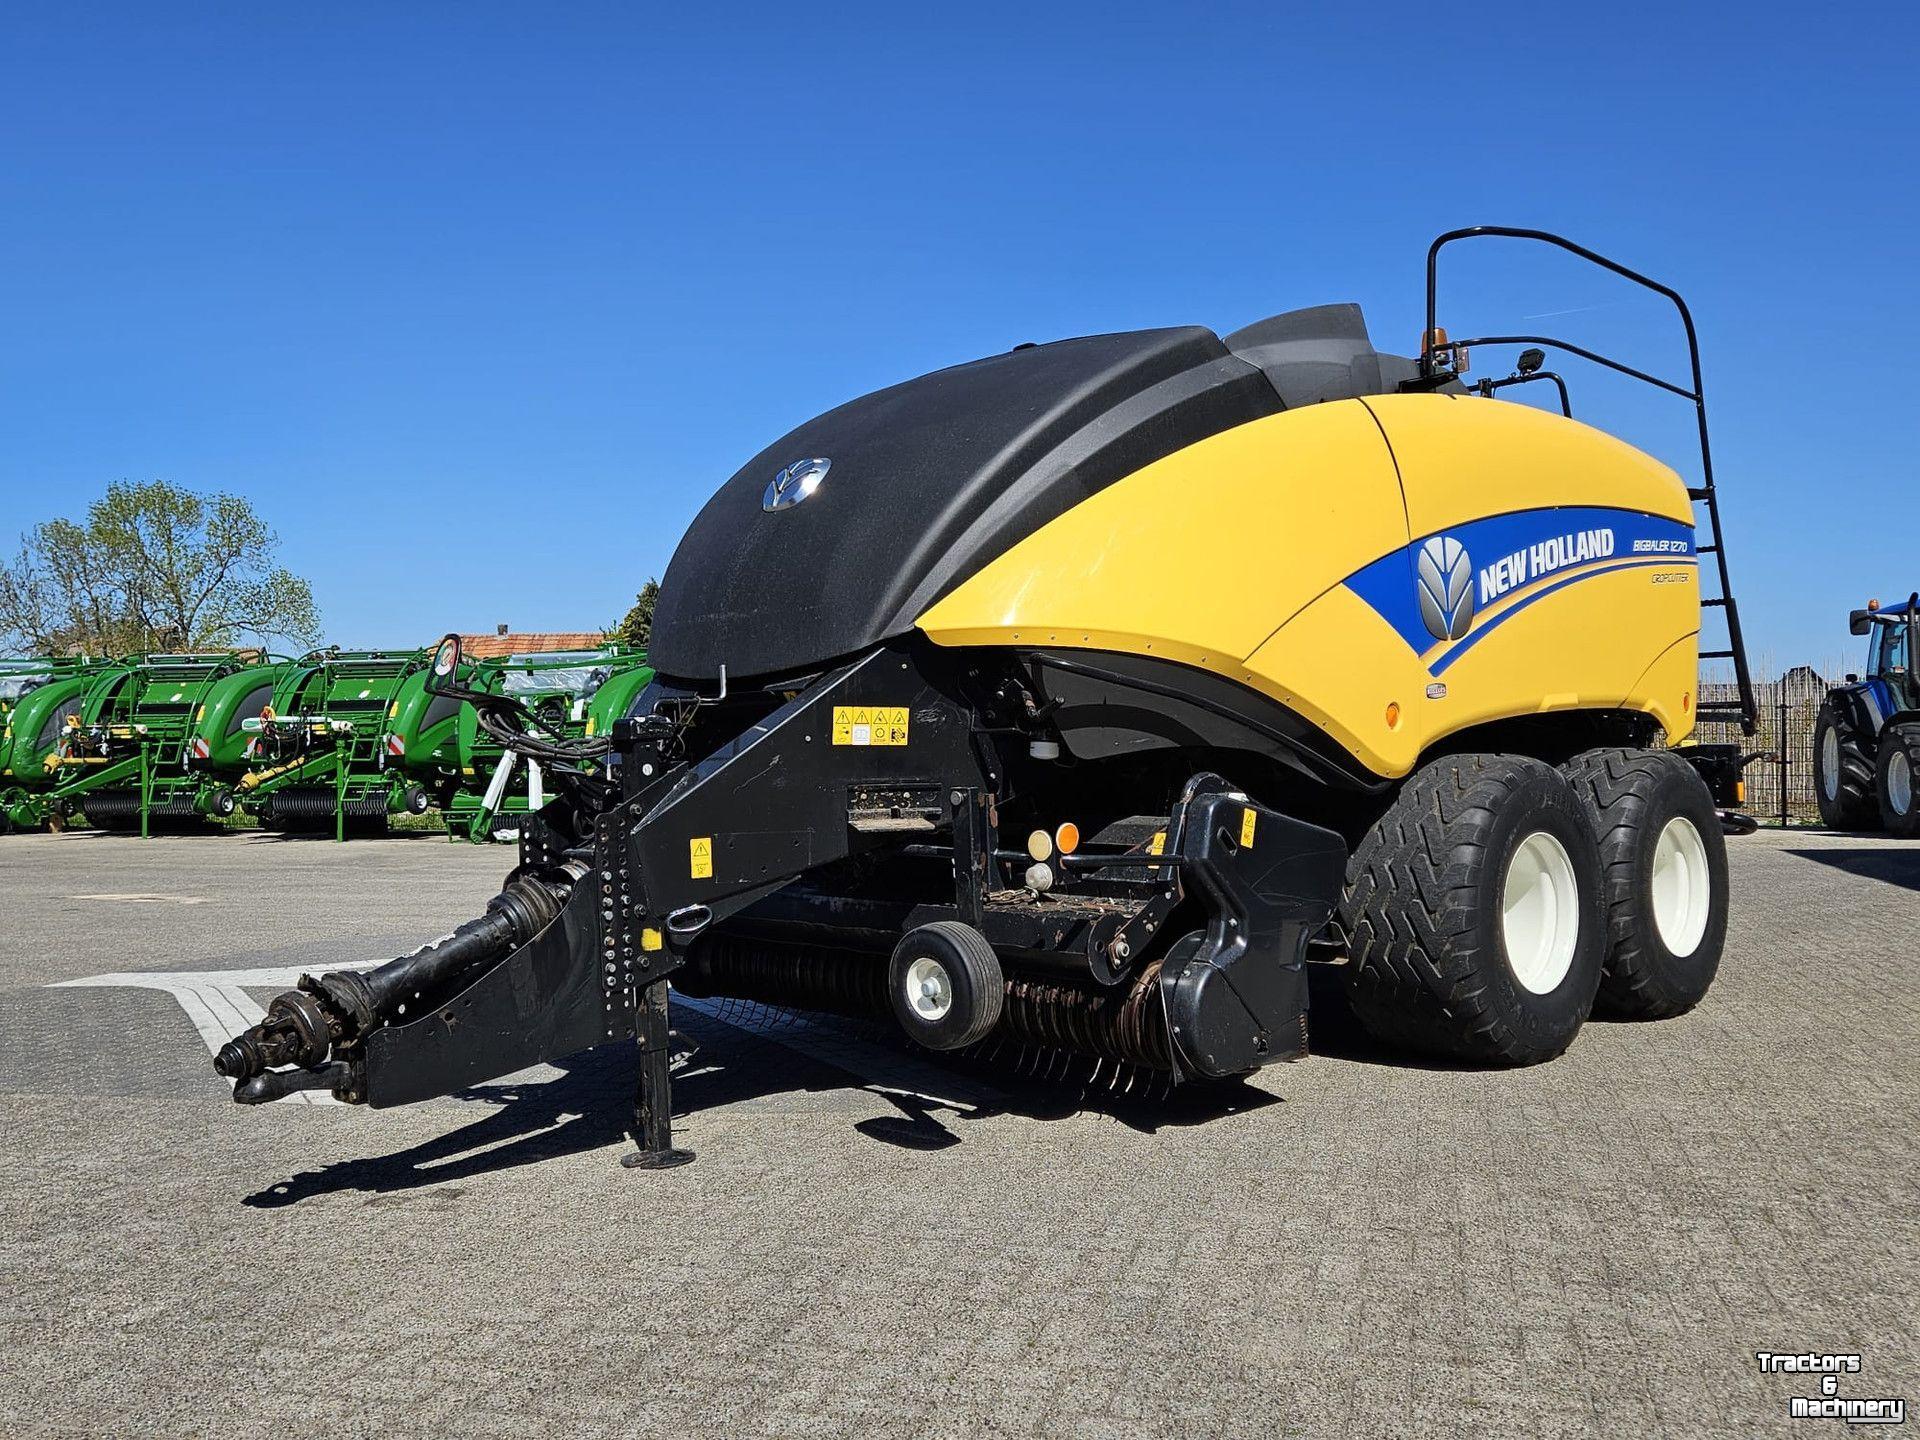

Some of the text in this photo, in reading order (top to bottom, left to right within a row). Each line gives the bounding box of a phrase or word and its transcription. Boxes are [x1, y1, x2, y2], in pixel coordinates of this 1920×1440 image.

[1480, 528, 1615, 604] NEW HOLLAND
[1632, 539, 1688, 553] BIGBALER 1270
